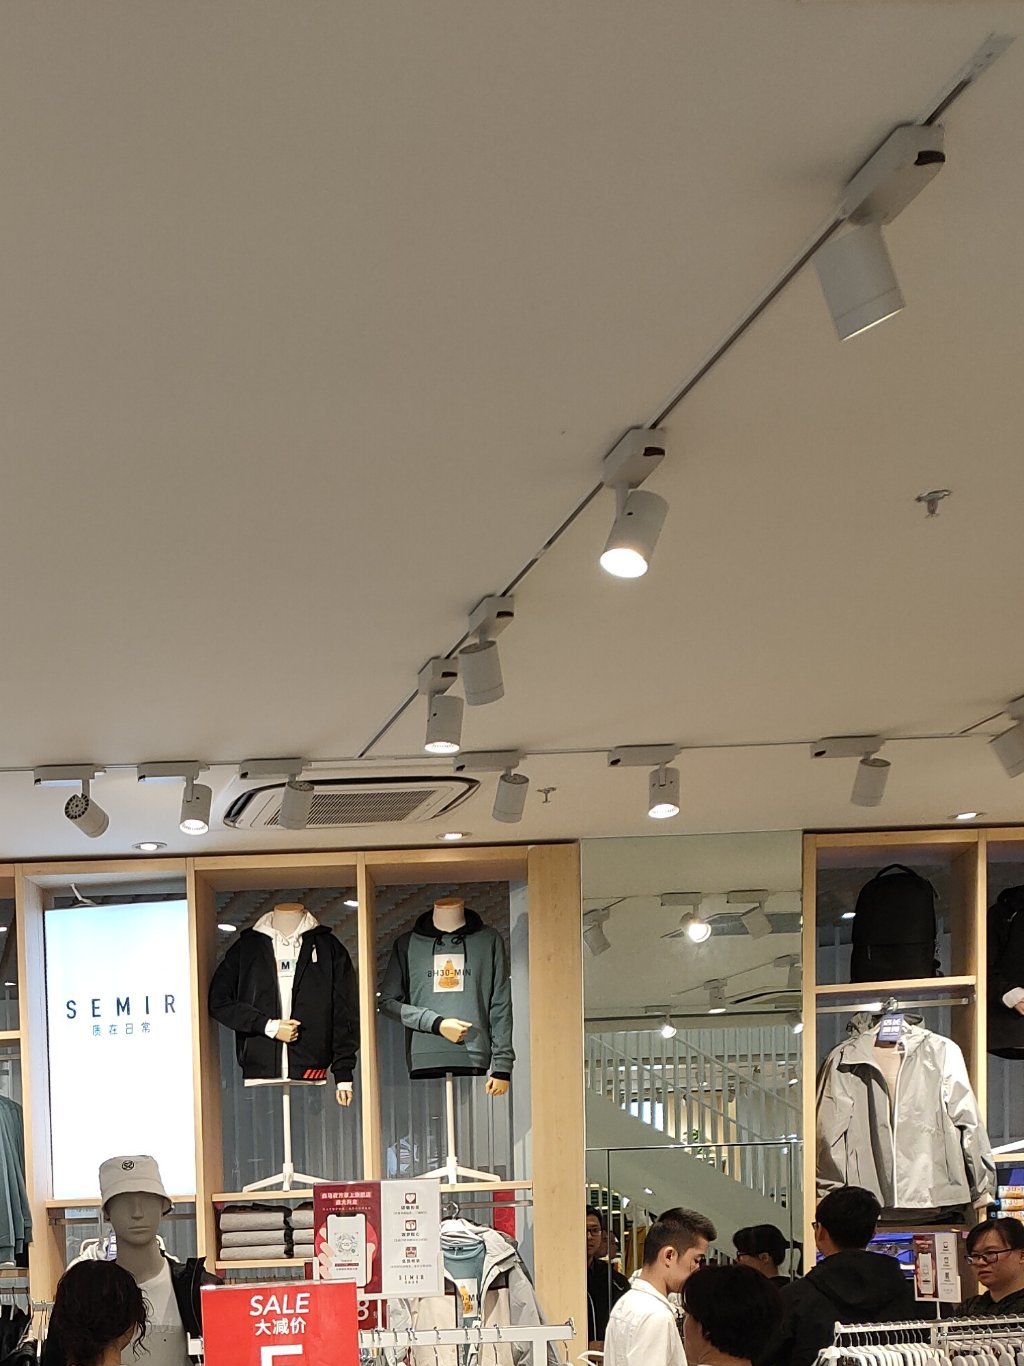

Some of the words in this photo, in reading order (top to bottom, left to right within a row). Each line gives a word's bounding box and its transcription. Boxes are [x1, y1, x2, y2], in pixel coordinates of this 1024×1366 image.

[66, 994, 176, 1019] SEMIR
[92, 1022, 151, 1037] 质在日常
[249, 1293, 311, 1317] SALE
[254, 1317, 307, 1337] 大减价
